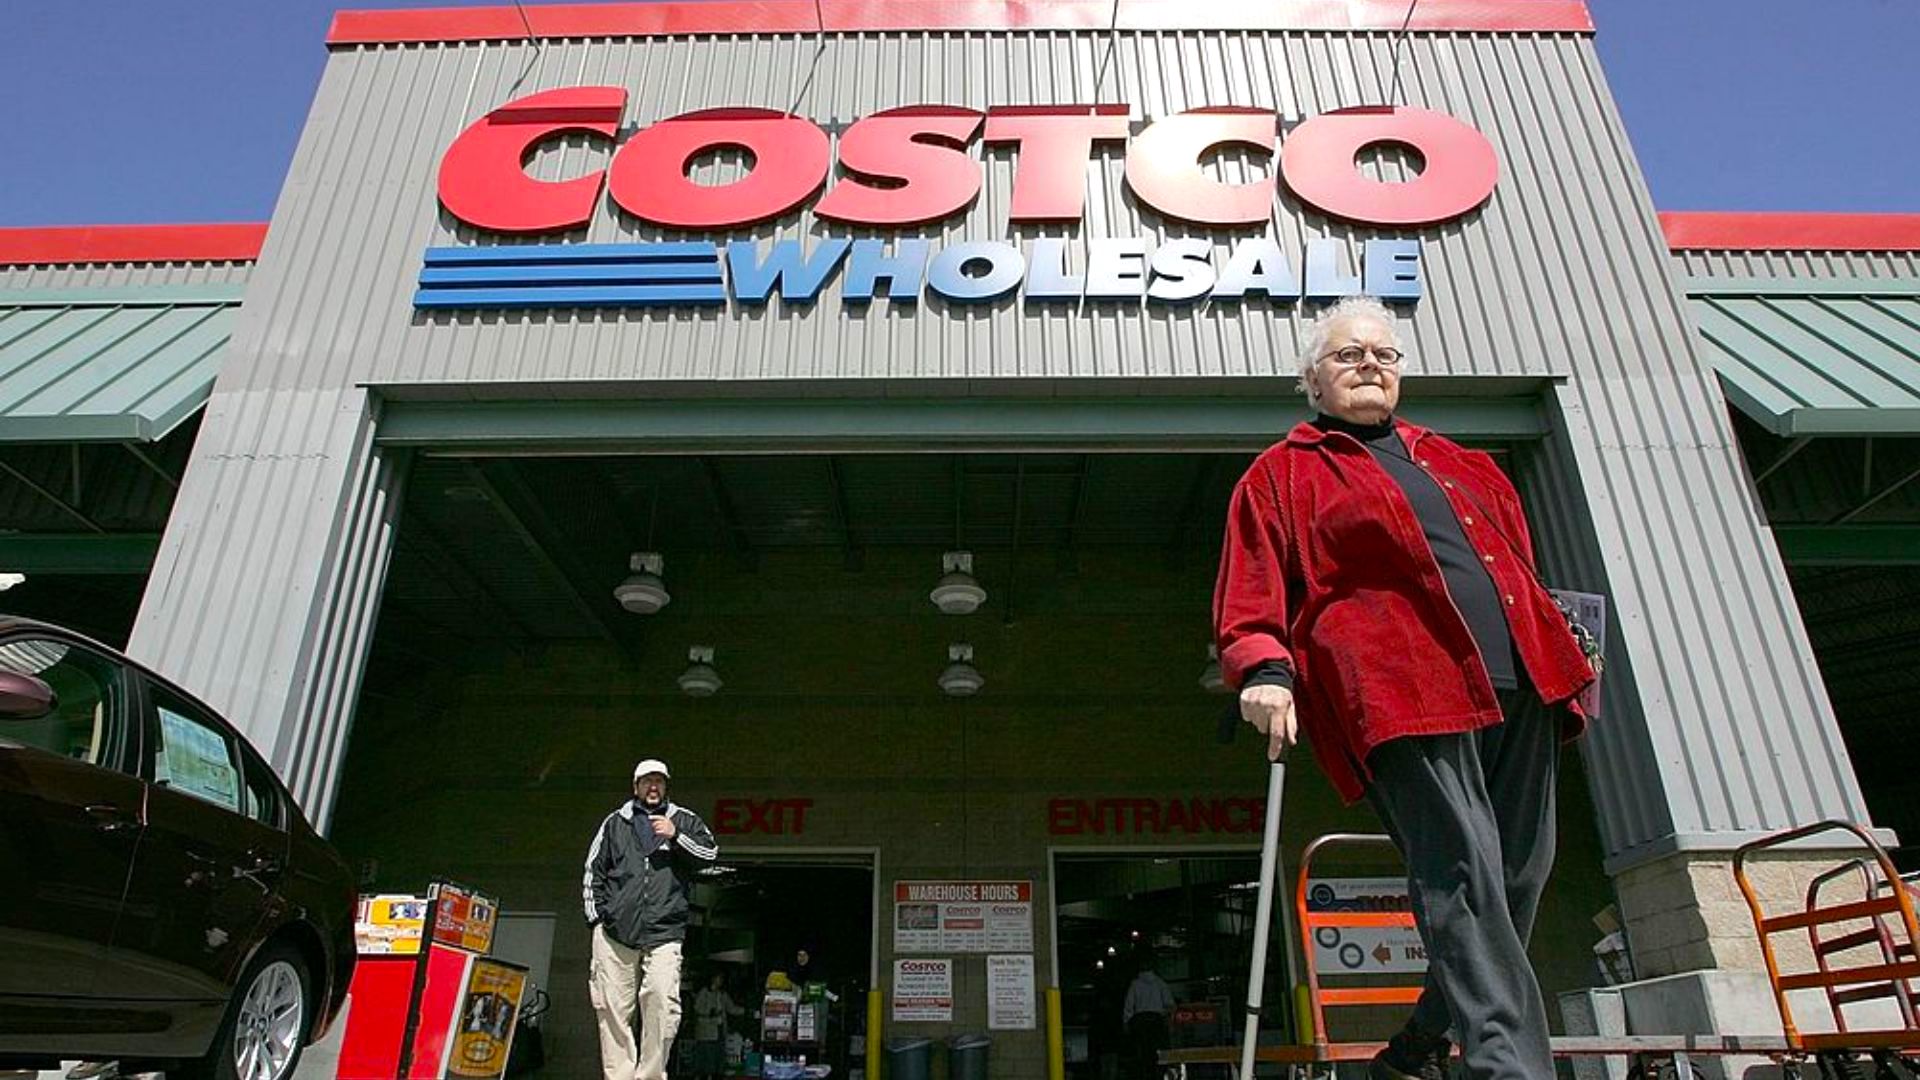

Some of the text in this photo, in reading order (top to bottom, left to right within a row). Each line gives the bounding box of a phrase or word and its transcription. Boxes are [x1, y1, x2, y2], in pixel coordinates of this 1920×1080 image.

[438, 86, 1498, 236] COSTCO
[727, 238, 1422, 300] WHOLESALE
[714, 799, 814, 834] EXIT
[908, 885, 1019, 900] WAREHOUSE HOURS
[946, 905, 981, 915] COSTCO
[993, 905, 1027, 914] COSTCO
[901, 961, 946, 971] COSTCO
